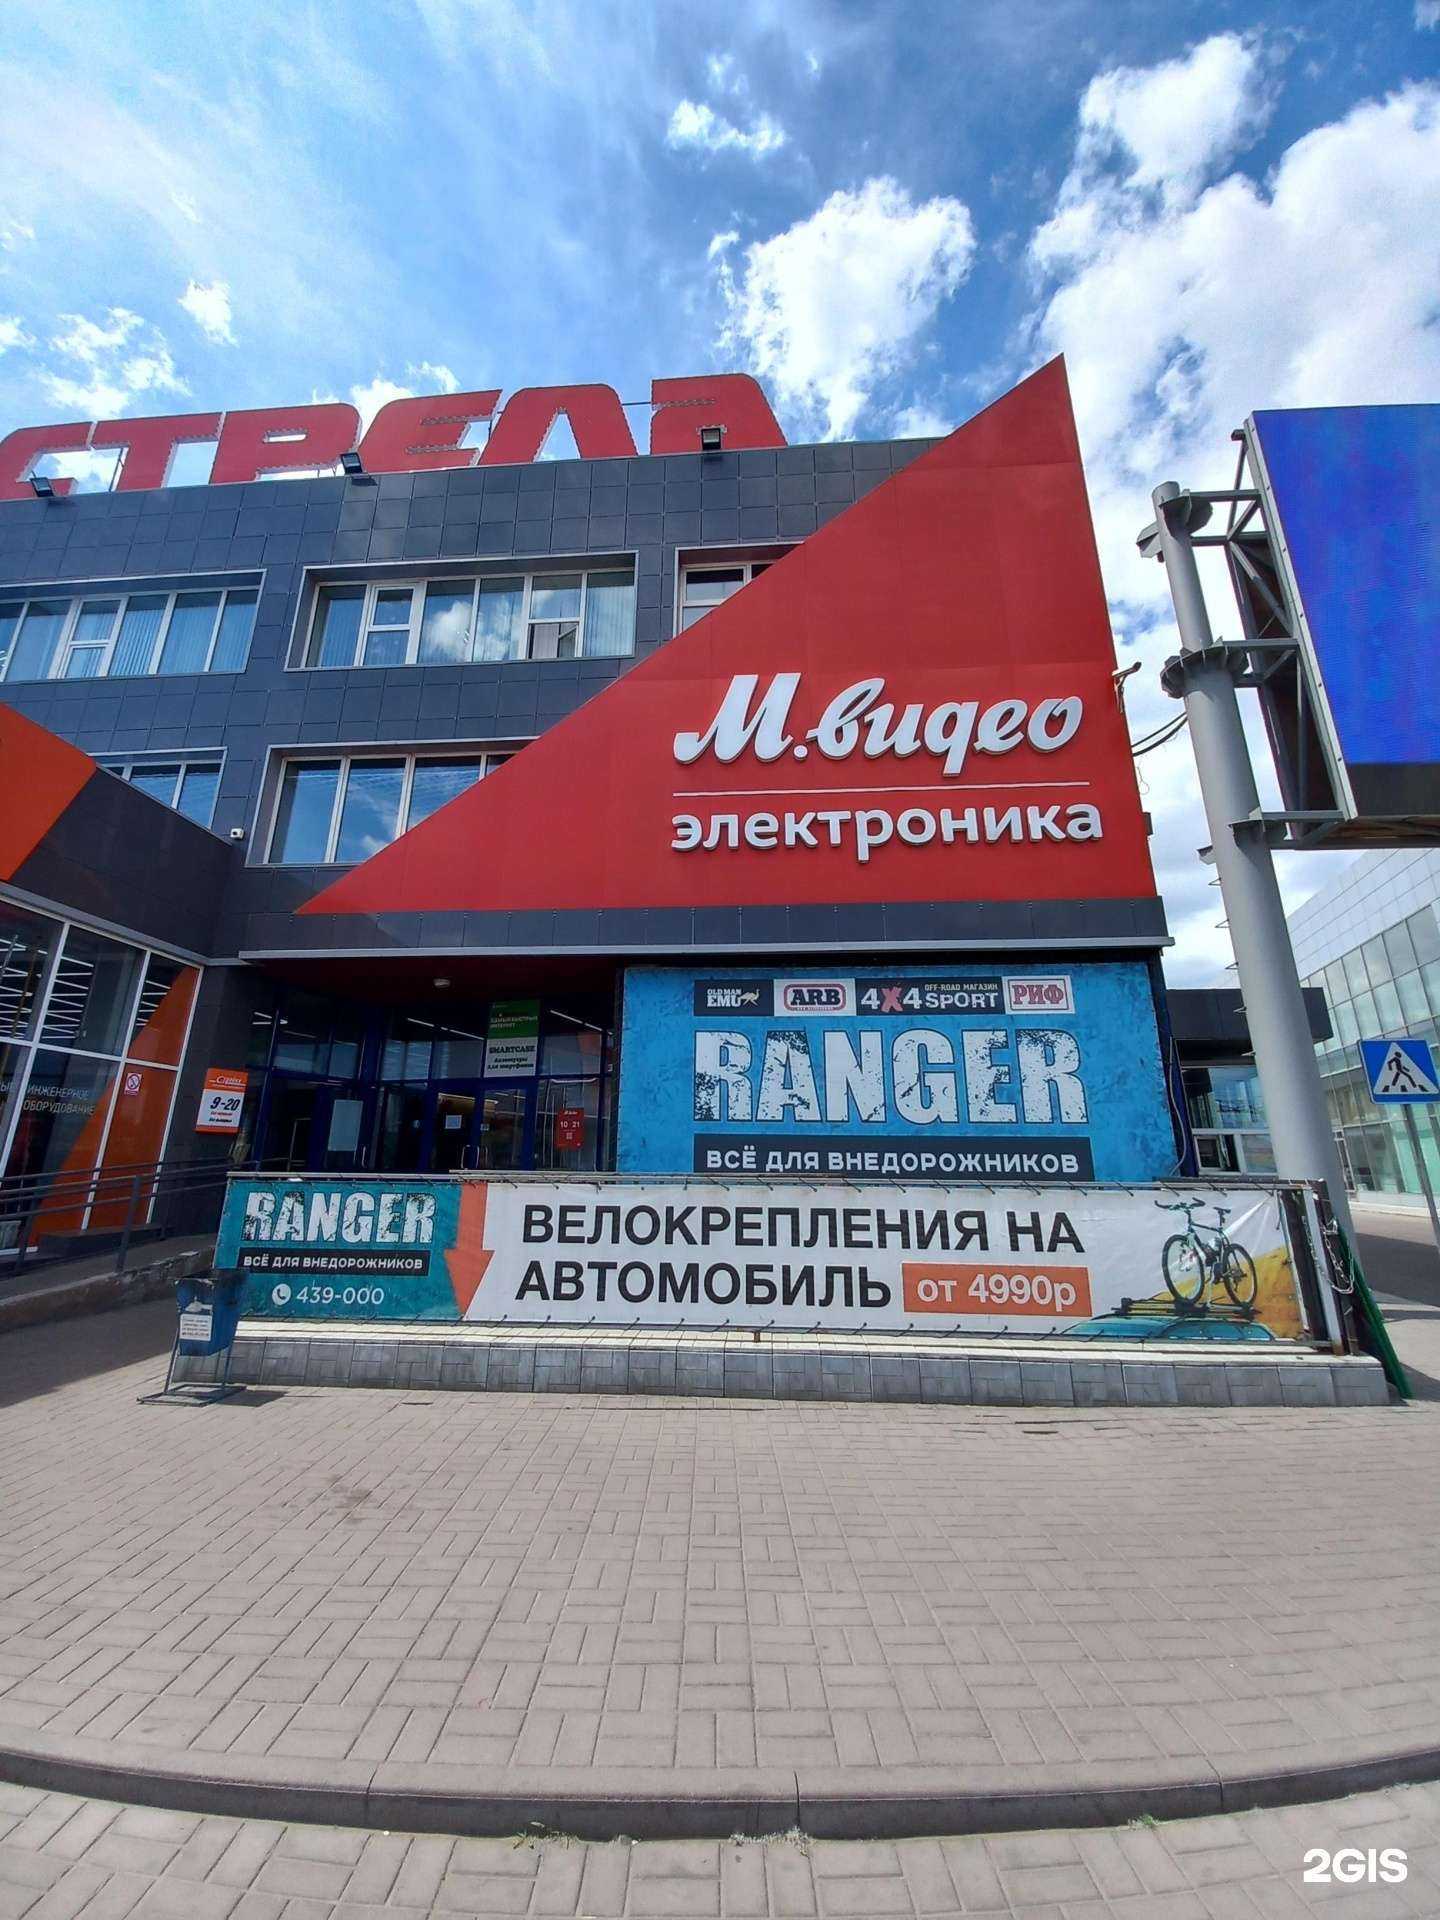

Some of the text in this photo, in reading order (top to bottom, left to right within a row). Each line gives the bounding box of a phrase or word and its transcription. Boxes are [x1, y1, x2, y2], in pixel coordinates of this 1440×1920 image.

[0, 373, 789, 501] СТРЕЛА
[671, 803, 1104, 863] электроника
[706, 988, 742, 996] OLD MAN
[790, 988, 841, 1006] ARB
[924, 983, 999, 991] OFF-ROAD МАГАЗИН
[1011, 984, 1065, 1006] РИФ
[706, 994, 741, 1008] EMU
[924, 992, 999, 1009] SPORT
[694, 1027, 1089, 1124] RANGER
[22, 1099, 96, 1116] ОБОРУДОВАНИЕ
[210, 1096, 241, 1111] 9-20
[706, 1145, 1080, 1173] ВСЁ ДЛЯ ВНЕДОРОЖНИКОВ
[241, 1190, 437, 1243] RANGER
[522, 1204, 1086, 1253] ВЕЛОКРЕПЛЕНИЯ НА
[243, 1253, 423, 1270] ВСЁ ДЛЯ ВНЕДОРОЖНИКОВ
[296, 1286, 385, 1306] 439-000
[515, 1260, 1077, 1313] АВТОМОБИЛЬ от 4990р
